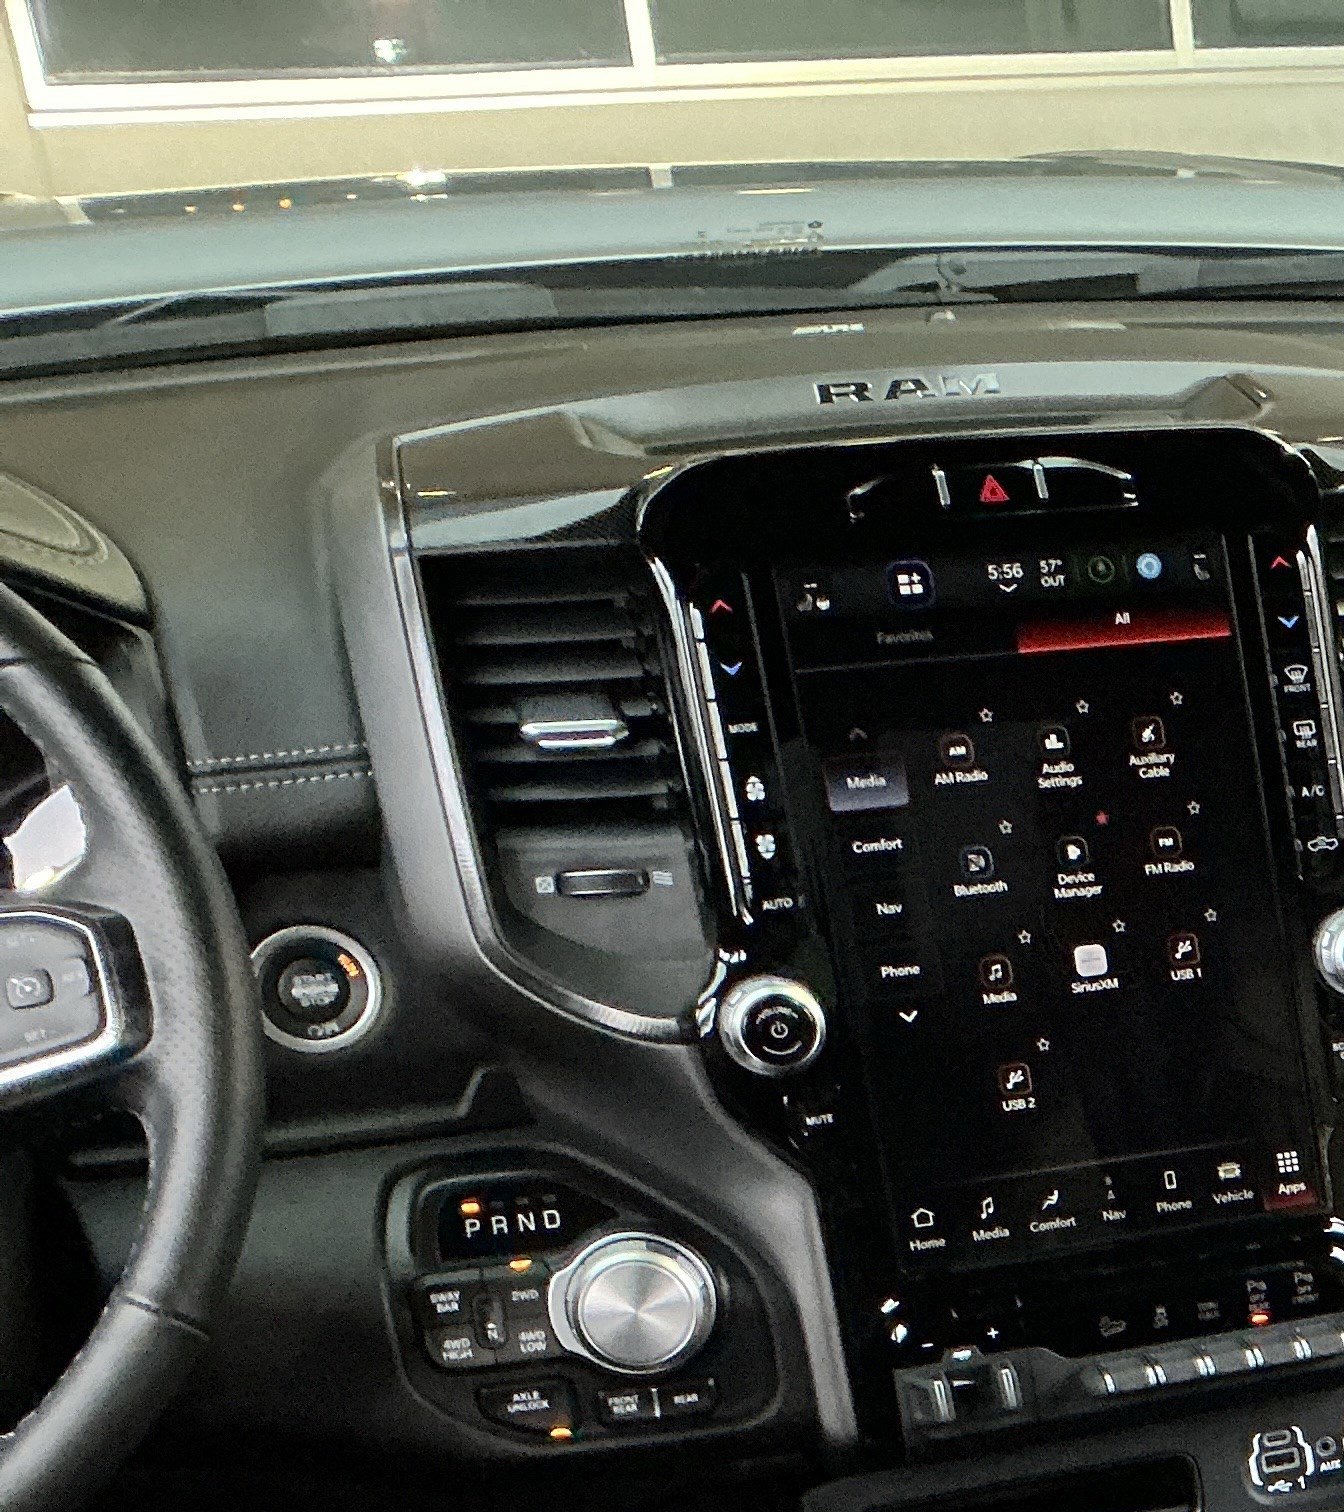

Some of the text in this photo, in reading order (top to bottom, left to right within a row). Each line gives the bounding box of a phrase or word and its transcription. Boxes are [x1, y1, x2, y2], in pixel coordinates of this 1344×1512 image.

[813, 372, 1000, 404] RAM
[988, 563, 1024, 580] 5:56
[1040, 575, 1065, 588] OUT
[1115, 611, 1131, 625] All
[1129, 752, 1176, 767] Auxiliary
[1042, 761, 1075, 774] Audio
[1139, 766, 1171, 779] Cable
[846, 774, 887, 789] Media
[934, 769, 989, 785] AM Radio
[1037, 775, 1083, 789] Settings
[1301, 784, 1326, 798] A/C
[852, 838, 904, 854] Comfort
[1144, 860, 1195, 876] FM Radio
[1057, 872, 1096, 885] Device
[953, 880, 1008, 897] Bluetooth
[1053, 885, 1103, 899] Manager
[762, 898, 794, 911] AUTO
[876, 902, 903, 915] Nav
[880, 965, 921, 979] Phone
[1171, 969, 1194, 981] USB
[1071, 977, 1119, 993] SiriusXM
[982, 990, 1018, 1005] Media
[1002, 1098, 1036, 1112] USB 2
[805, 1113, 834, 1126] MUTE
[1278, 1181, 1307, 1196] Apps
[1212, 1189, 1255, 1205] Vehicle
[1156, 1199, 1193, 1213] Phone
[1102, 1210, 1127, 1222] Nav
[1030, 1216, 1078, 1233] Comfort
[972, 1226, 1010, 1242] Media
[909, 1237, 947, 1251] Home
[519, 1341, 547, 1353] LOW
[1319, 1459, 1342, 1472] AUX
[1298, 1475, 1306, 1490] 1
